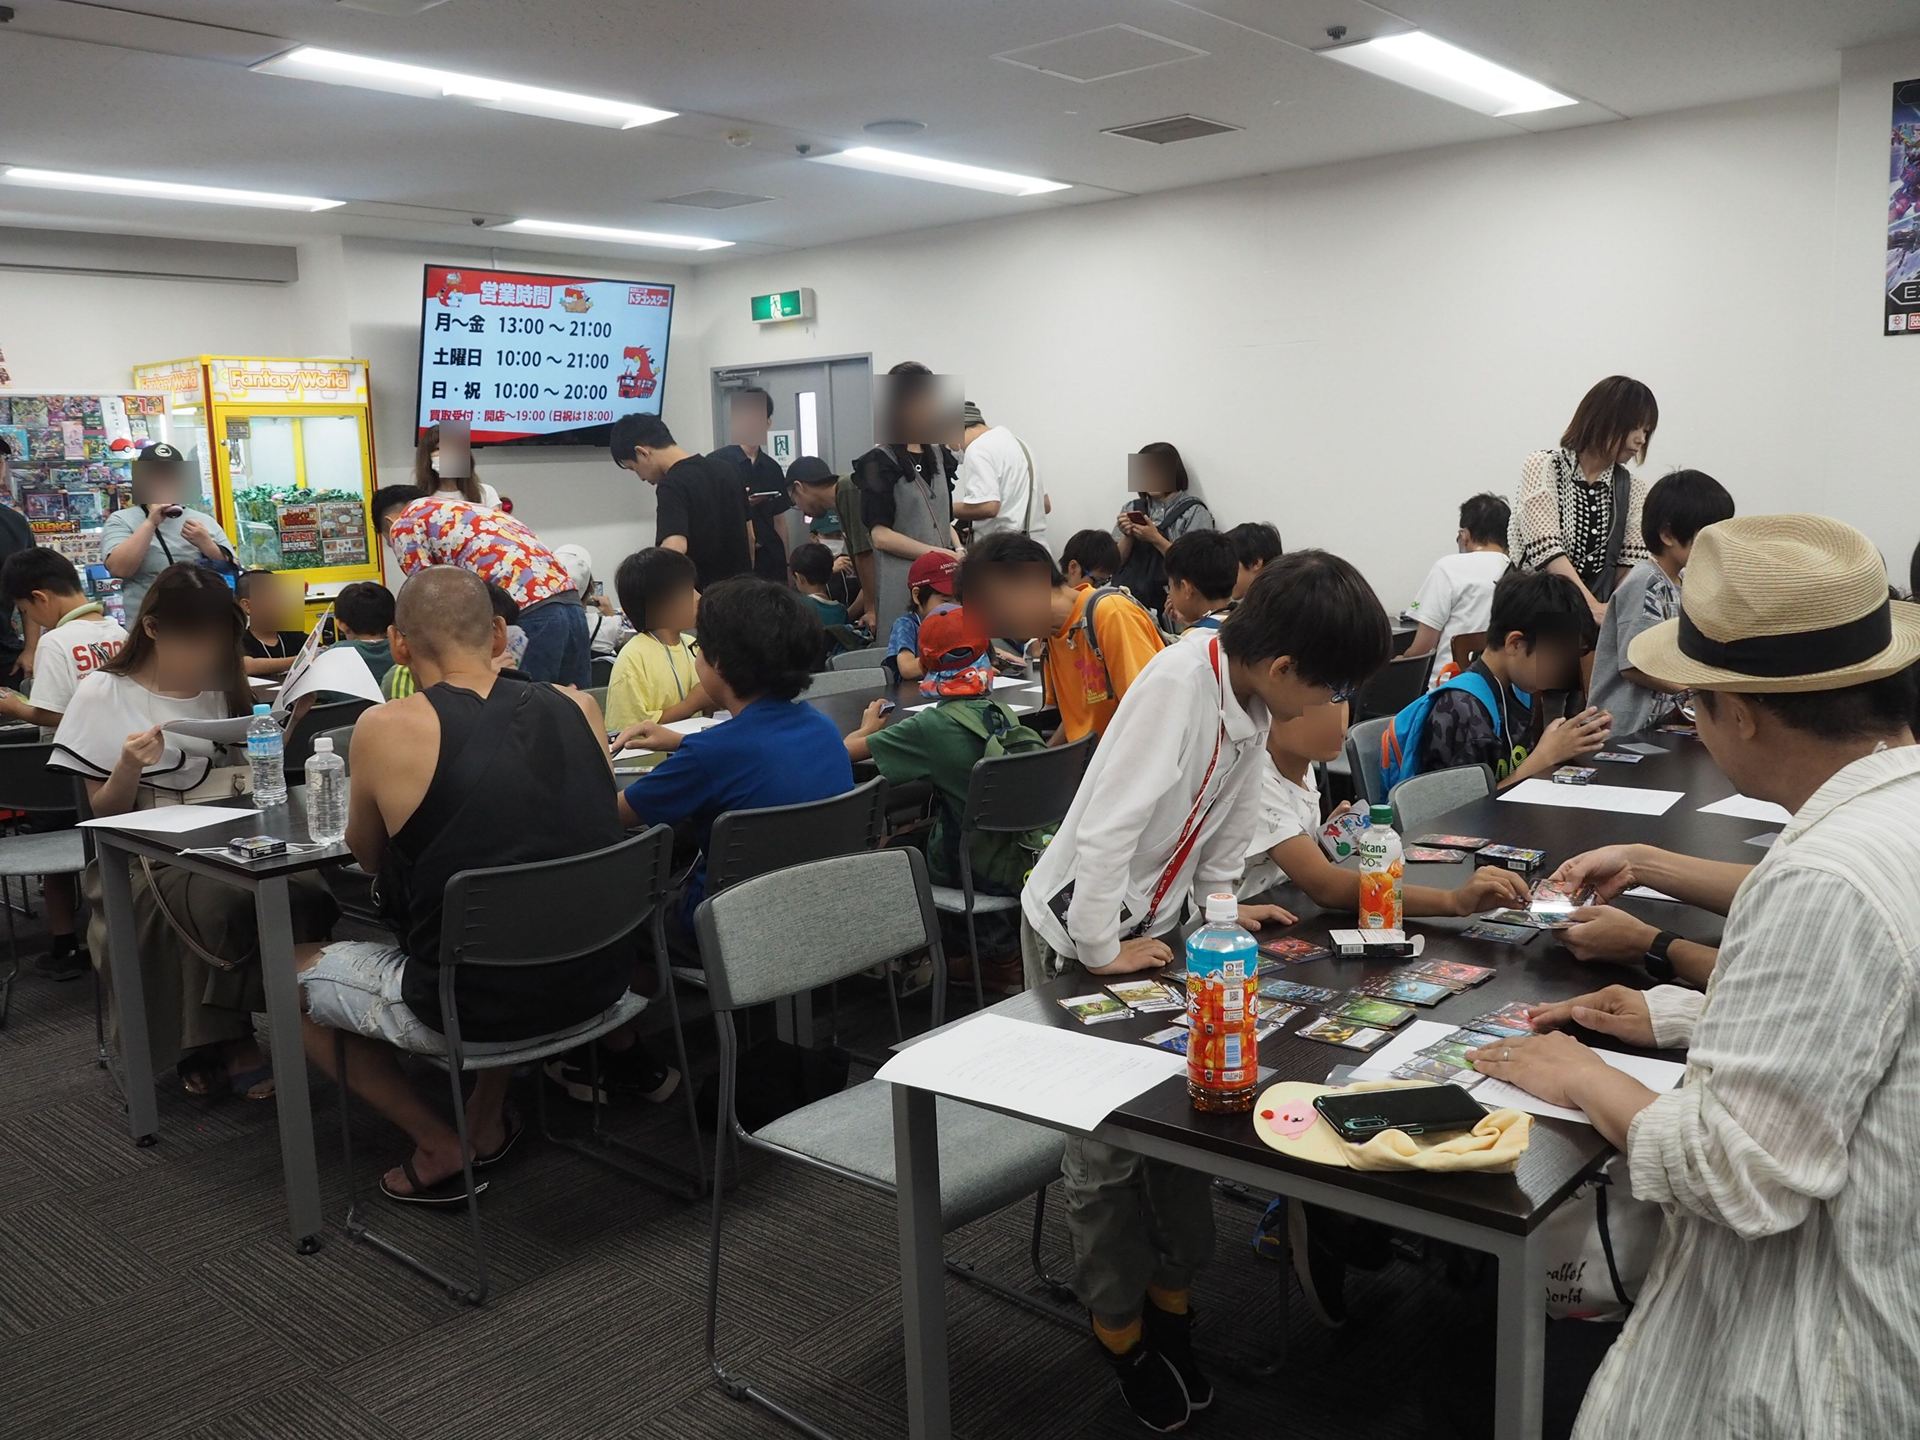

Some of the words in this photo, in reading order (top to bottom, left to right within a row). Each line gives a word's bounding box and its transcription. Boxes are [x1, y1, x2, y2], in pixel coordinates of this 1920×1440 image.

[480, 281, 552, 308] 営業時間
[432, 347, 483, 367] 土曜日
[31, 522, 72, 532] ALLENGE
